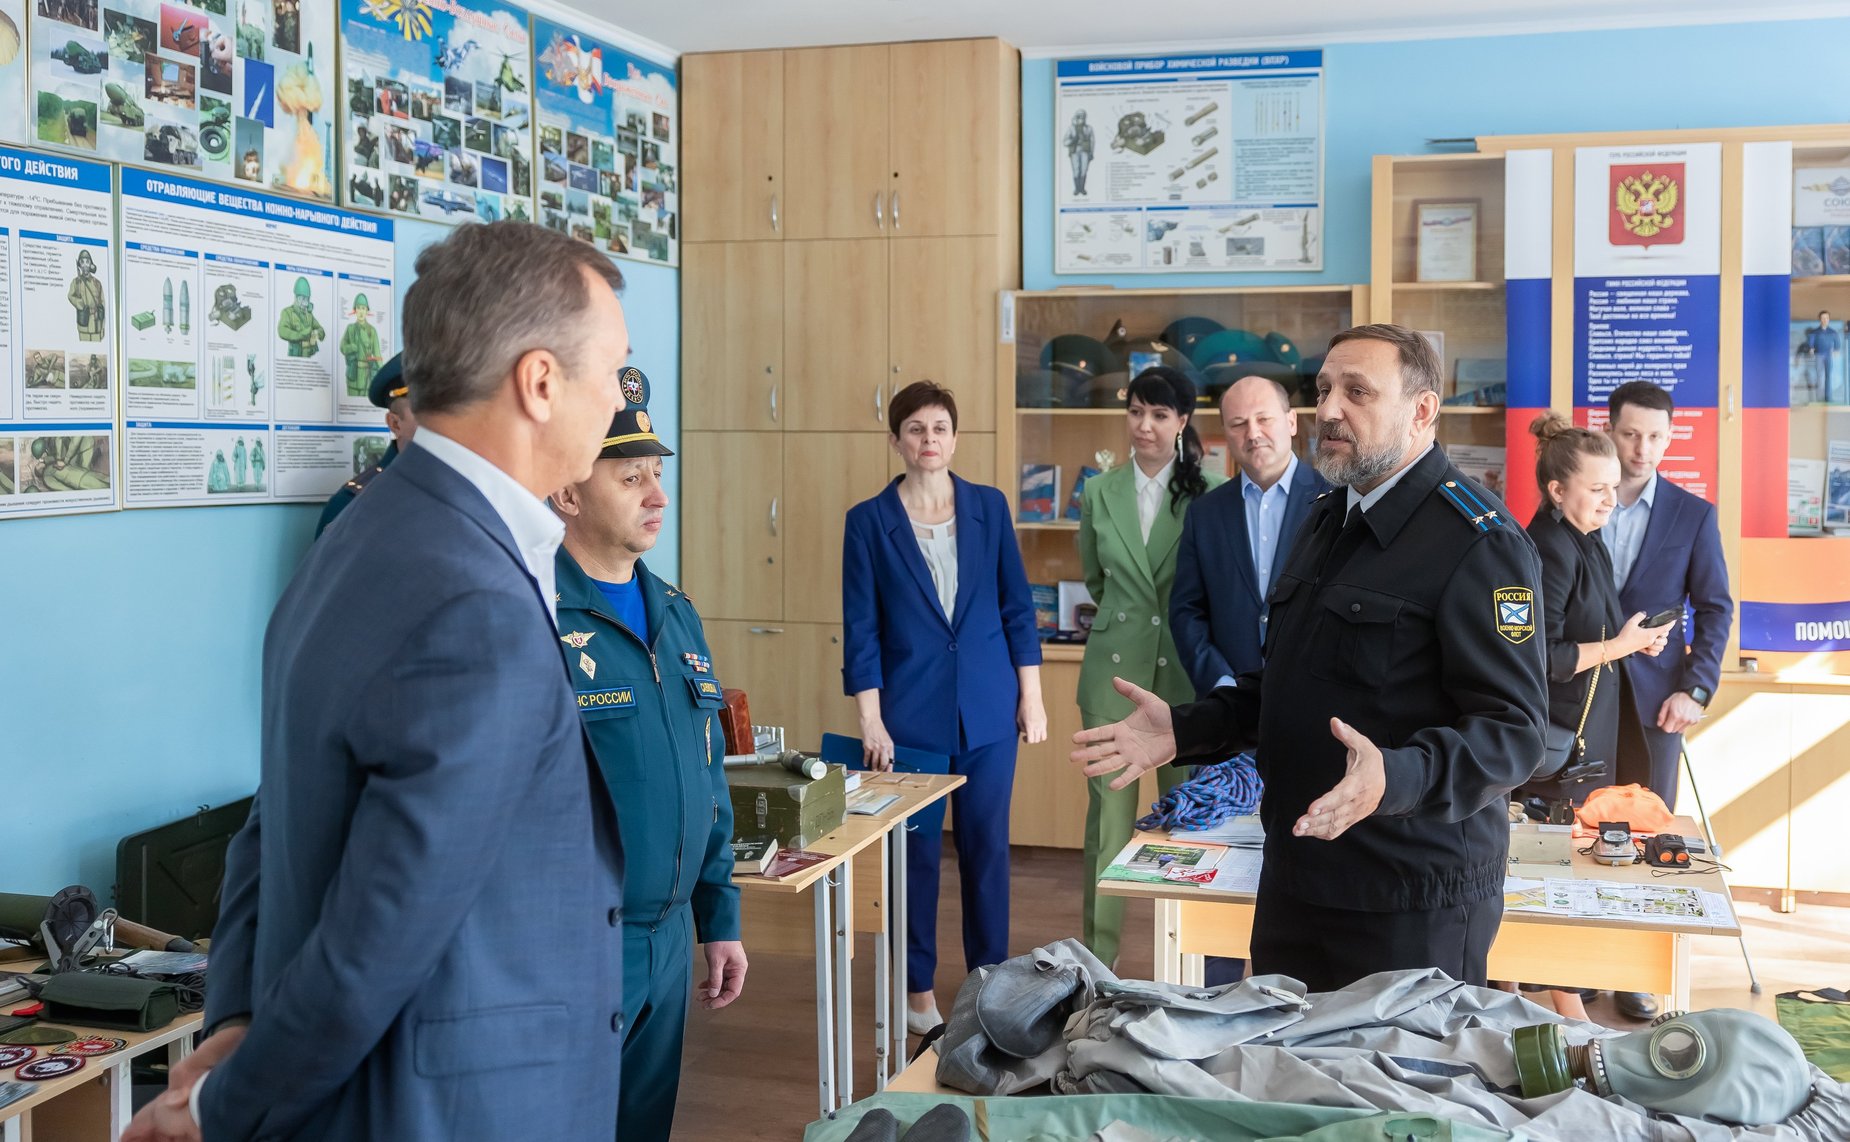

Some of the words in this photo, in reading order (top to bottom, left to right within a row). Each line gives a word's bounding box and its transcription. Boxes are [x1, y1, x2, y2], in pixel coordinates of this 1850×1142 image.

[1089, 61, 1132, 72] ВОЙСКОВОЙ
[1134, 61, 1165, 70] ПРИБОР
[1167, 56, 1217, 69] ХИМИЧЕСКОЙ
[1218, 57, 1259, 67] РАЗВЕДКИ
[1261, 55, 1290, 66] (ВПХР)
[0, 155, 21, 171] ОГО
[24, 159, 78, 180] ДЕЙСТВИЯ
[146, 179, 216, 204] ОТРАВЛЯЮЩИЕ
[219, 193, 264, 213] ВЕЩЕСТВА
[265, 202, 340, 226] КОЖНО-НАРЫВНОГО
[341, 217, 377, 233] ДЕЙСТВИЯ
[1825, 197, 1850, 207] СОЮ
[1497, 592, 1531, 601] РОССИЯ
[590, 691, 632, 706] РОССИИ
